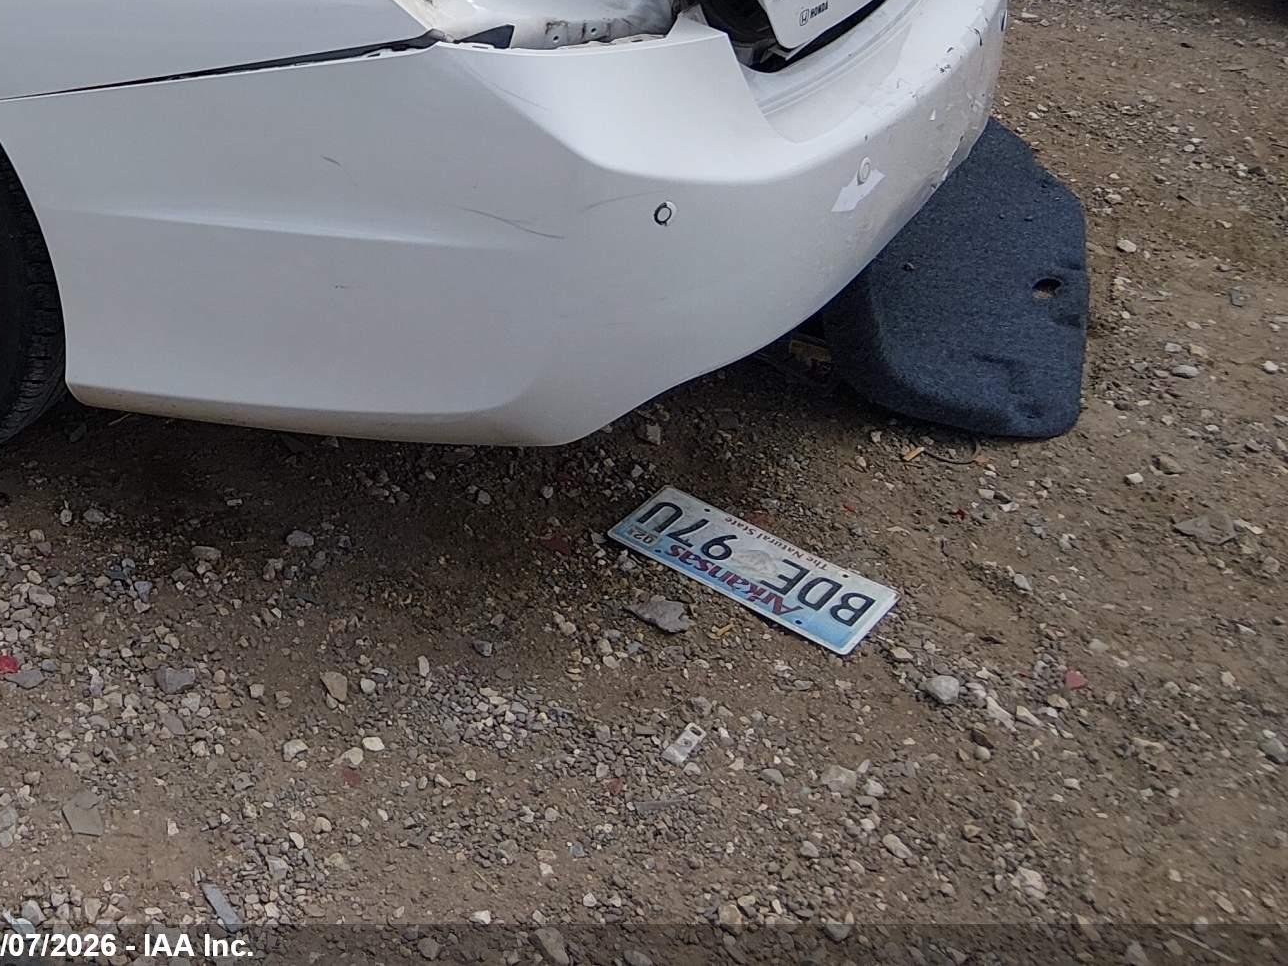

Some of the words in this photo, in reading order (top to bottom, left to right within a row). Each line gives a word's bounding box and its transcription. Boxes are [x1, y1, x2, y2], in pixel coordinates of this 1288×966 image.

[810, 0, 829, 18] HONDA
[636, 501, 739, 561] 97U
[724, 516, 756, 536] State
[757, 533, 803, 559] Natural
[806, 557, 828, 571] The
[666, 544, 804, 616] Arkansas
[760, 558, 877, 627] BDE
